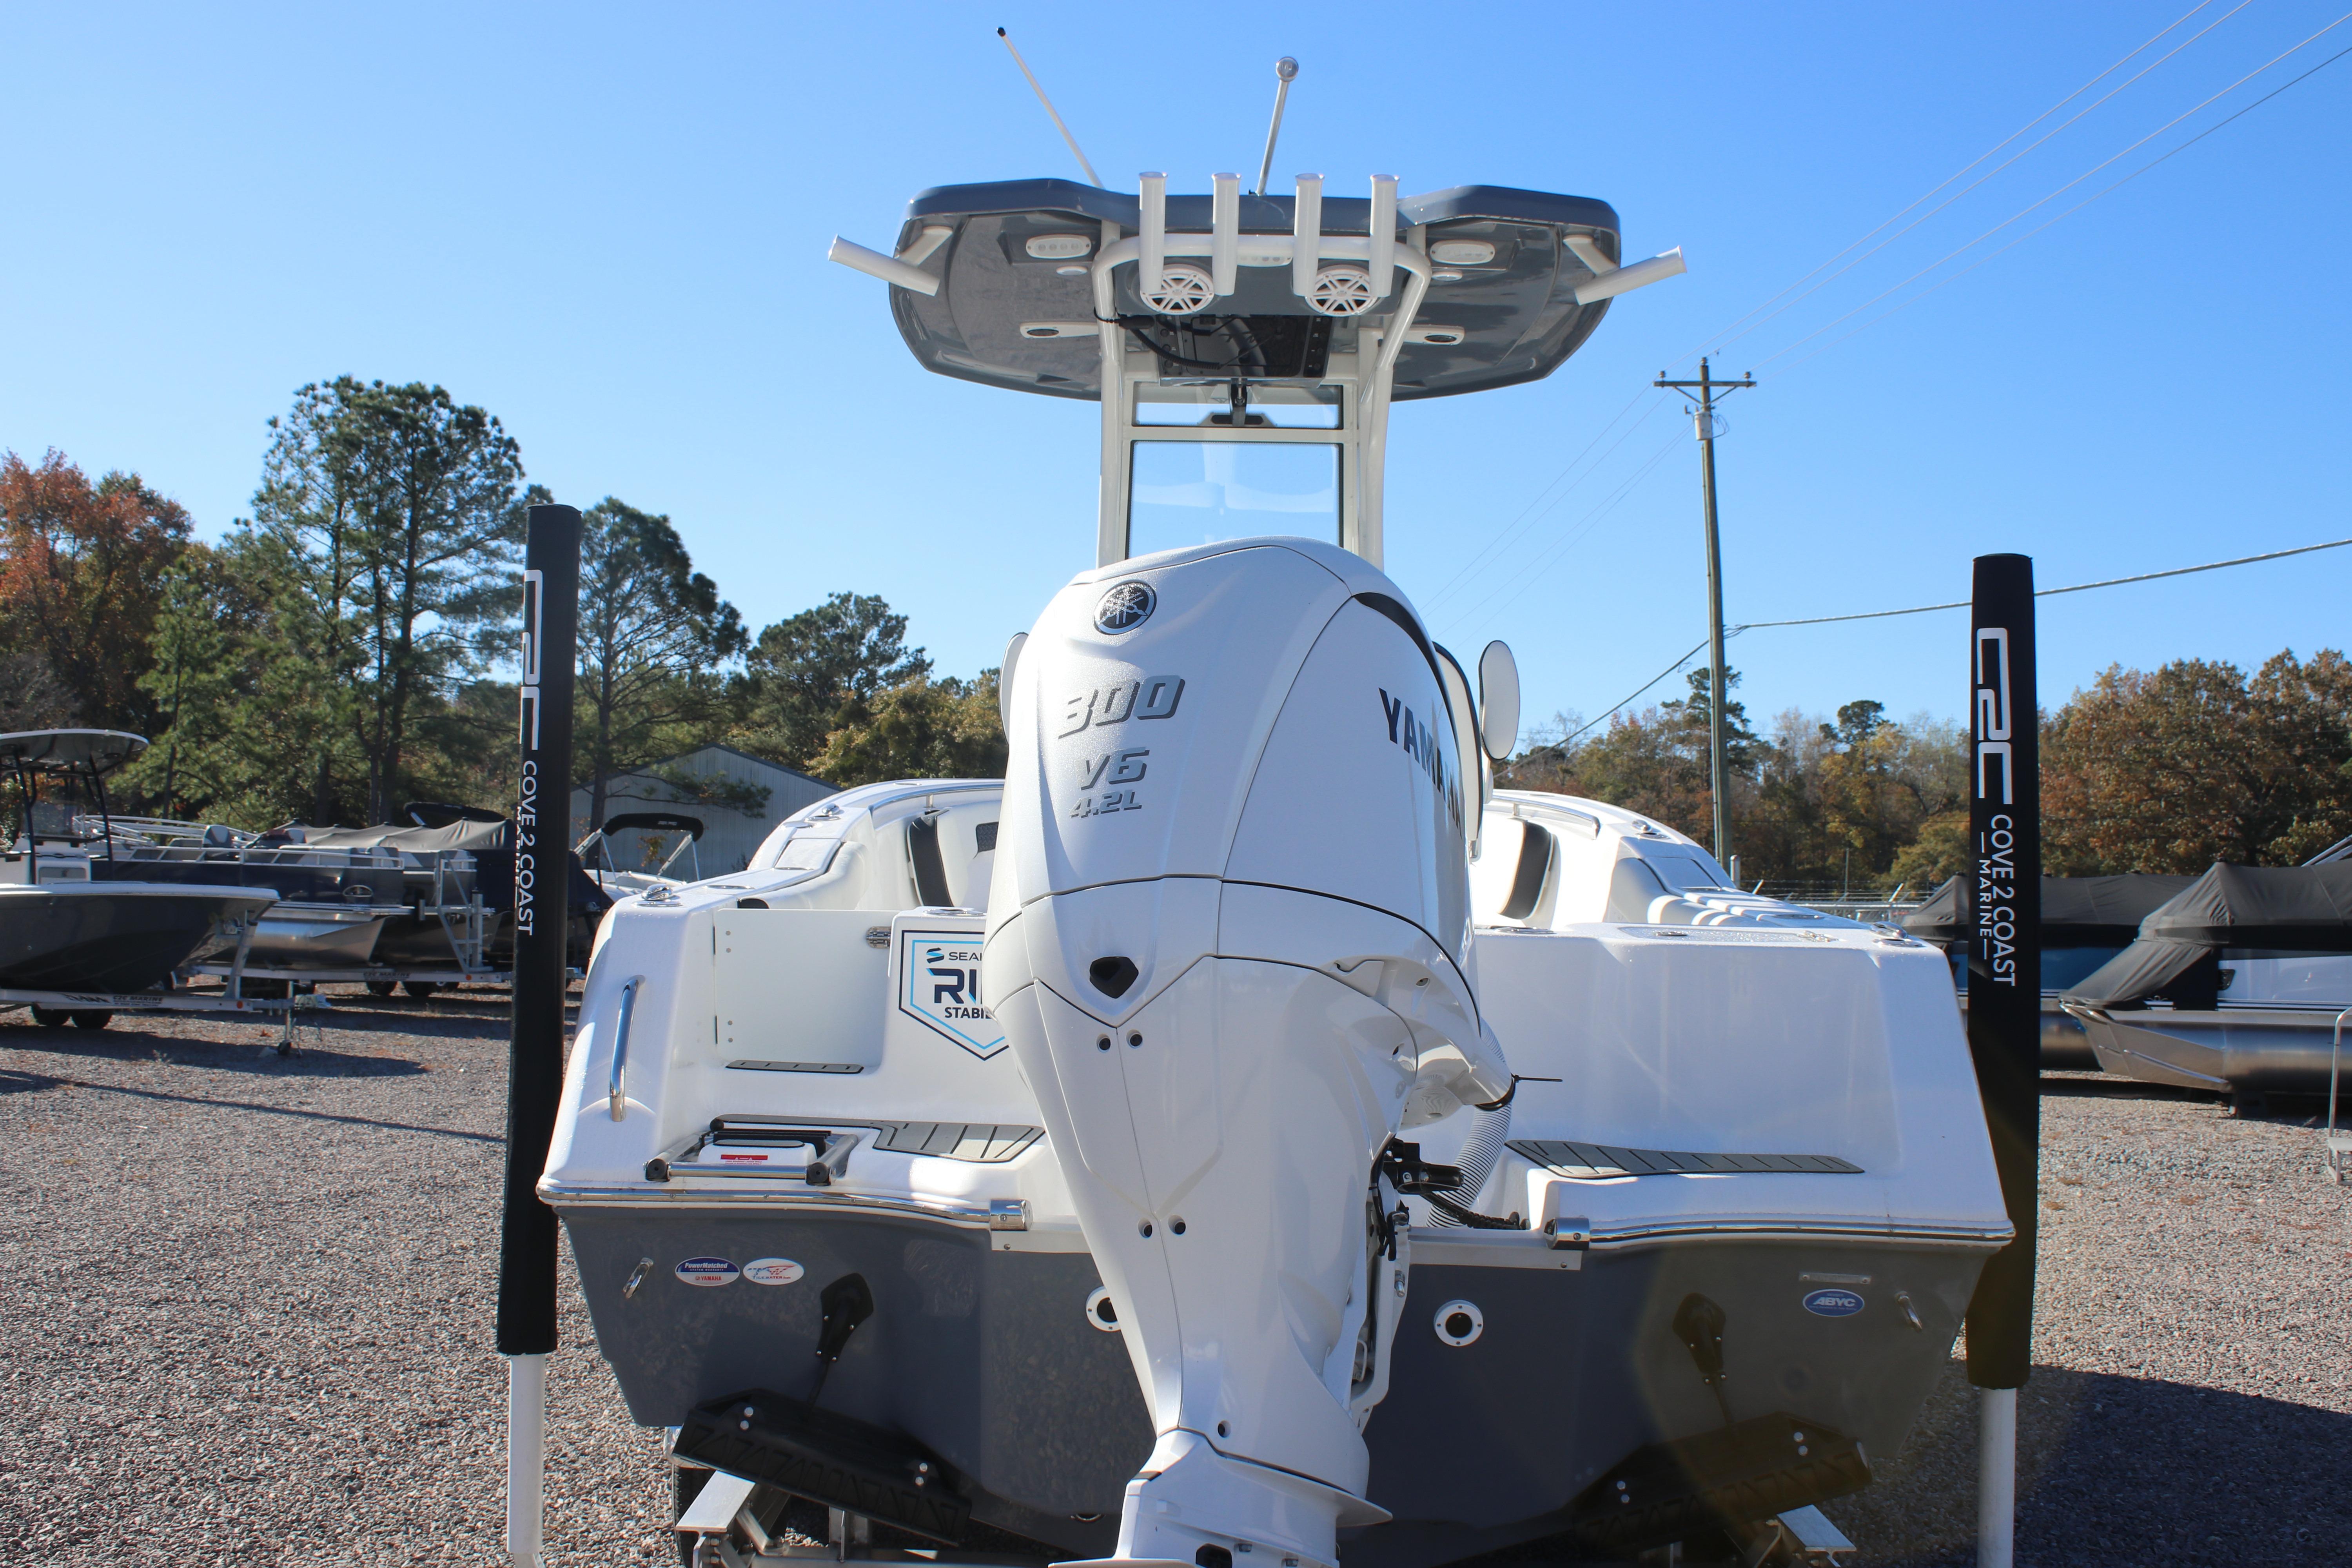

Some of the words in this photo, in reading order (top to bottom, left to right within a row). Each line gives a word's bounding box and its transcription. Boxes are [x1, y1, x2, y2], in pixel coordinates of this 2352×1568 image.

[1058, 675, 1185, 739] 300
[521, 760, 537, 826] COVE
[1075, 747, 1150, 790] V6
[1378, 687, 1462, 840] YAMAHA
[1069, 789, 1142, 818] 4.2L
[521, 834, 535, 846] 2
[1991, 814, 2014, 879] COVE
[518, 853, 535, 936] COAST
[1978, 859, 1992, 937] MARINE
[1993, 886, 2014, 899] 2
[1993, 906, 2016, 986] COAST
[926, 968, 983, 1005] RI
[1813, 1297, 1856, 1307] ABYC
